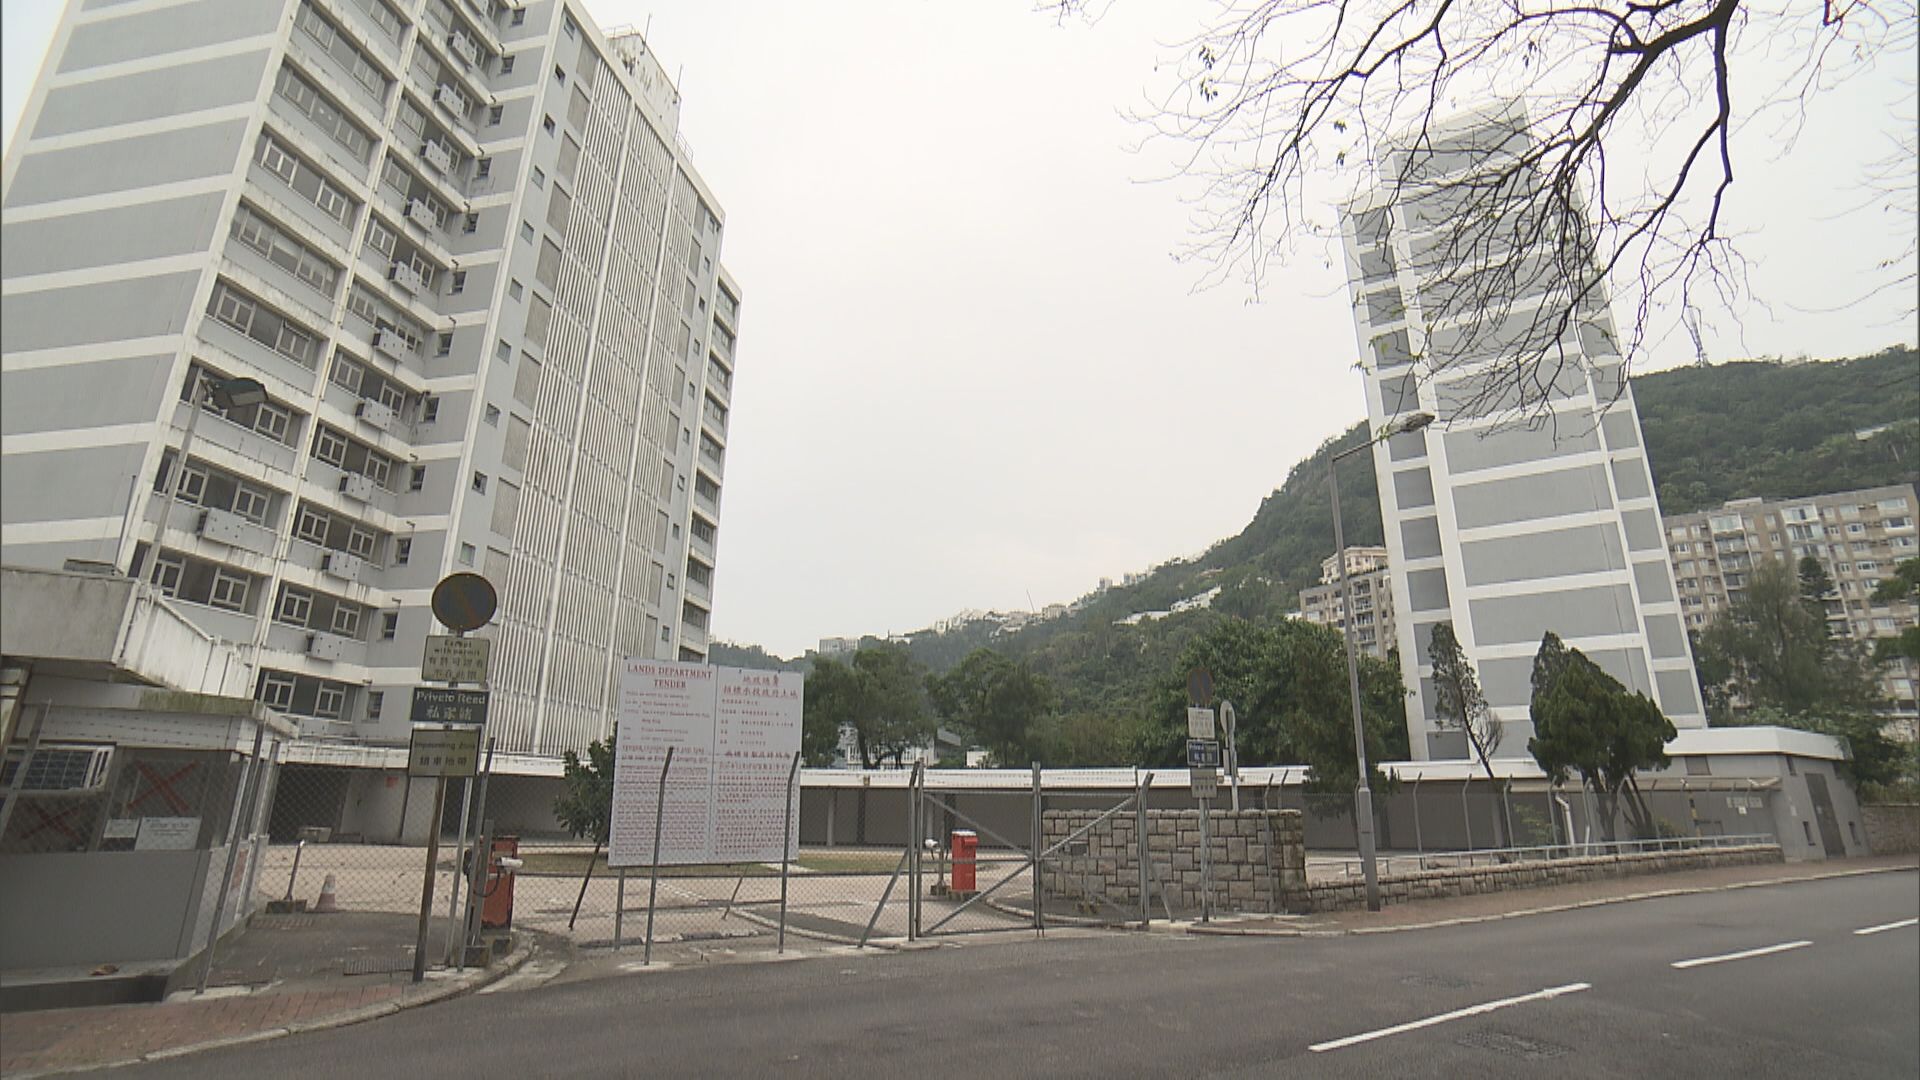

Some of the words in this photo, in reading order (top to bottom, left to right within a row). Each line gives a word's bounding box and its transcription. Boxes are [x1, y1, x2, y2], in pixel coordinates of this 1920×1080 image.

[627, 663, 656, 675] LANDS
[658, 666, 713, 680] DEPARTMENT
[654, 679, 687, 689] TENDER
[416, 690, 456, 702] Private
[457, 693, 486, 705] Road
